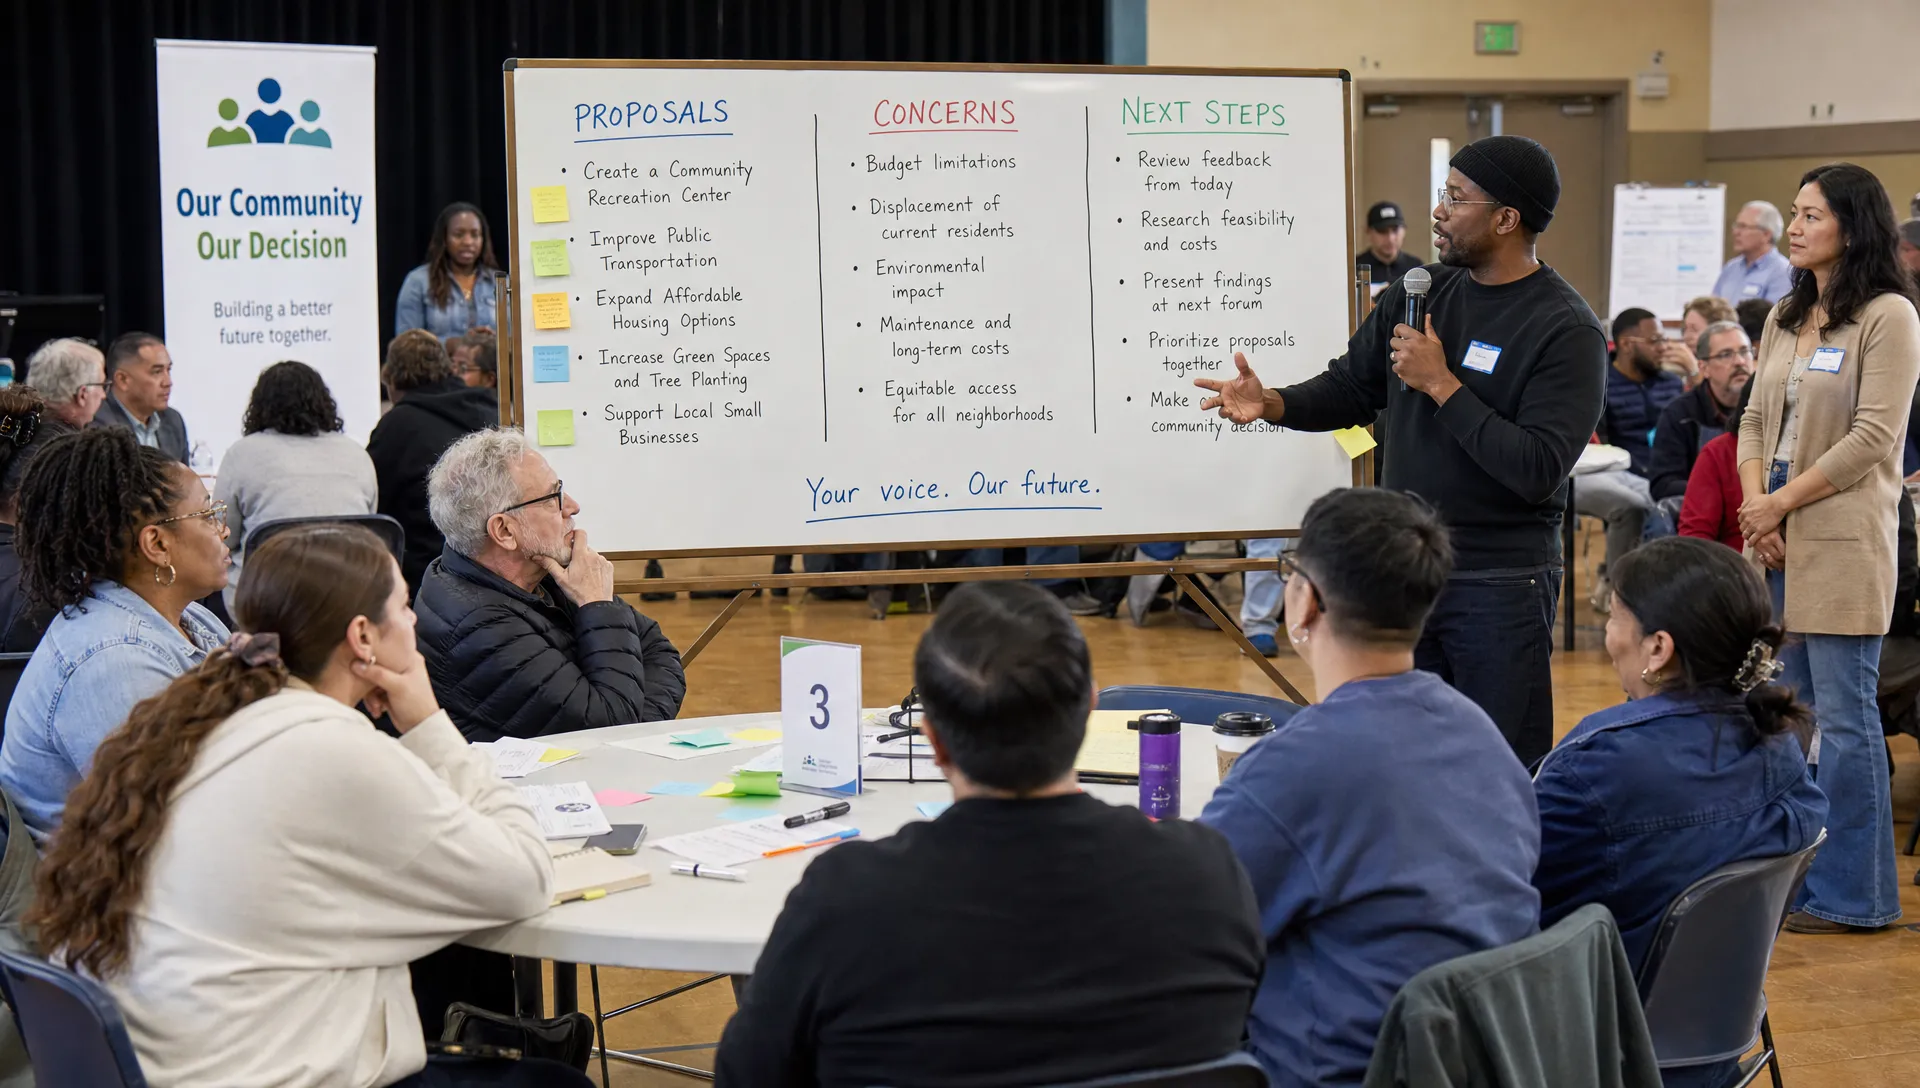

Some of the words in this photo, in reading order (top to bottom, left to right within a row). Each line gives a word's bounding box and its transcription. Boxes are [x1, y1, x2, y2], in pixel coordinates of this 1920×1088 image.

[575, 99, 729, 132] PROPOSALS
[874, 99, 1015, 127] CONCERNS
[1123, 96, 1191, 125] NEXT
[1206, 100, 1285, 126] STEPS
[866, 154, 922, 180] Budget
[935, 153, 1016, 170] limitations
[1138, 150, 1189, 167] Review
[1202, 150, 1271, 167] feedback
[584, 161, 639, 180] Create
[649, 168, 658, 178] a
[670, 160, 752, 186] Community
[588, 189, 670, 206] Recreation
[682, 187, 731, 202] Center
[1145, 175, 1180, 191] from
[1190, 176, 1233, 199] today
[176, 187, 222, 217] Our
[230, 186, 363, 225] Community
[870, 196, 973, 220] Displacement
[984, 194, 1000, 211] of
[882, 224, 937, 239] current
[948, 222, 1014, 237] residents
[1142, 210, 1209, 227] Research
[1221, 209, 1294, 235] feasibility
[197, 231, 241, 260] Our
[249, 229, 347, 259] Decision
[590, 231, 656, 252] Improve
[667, 227, 711, 243] Public
[1144, 236, 1169, 251] and
[1180, 235, 1217, 250] costs
[600, 253, 717, 276] Transportation
[877, 256, 984, 275] Environmental
[893, 282, 944, 304] impact
[1144, 272, 1204, 289] Present
[1214, 271, 1271, 295] findings
[597, 289, 652, 310] Expand
[664, 286, 743, 303] Affordable
[1152, 297, 1168, 312] at
[1179, 296, 1211, 311] next
[1221, 294, 1262, 310] forum
[214, 301, 273, 322] Building
[278, 304, 285, 316] a
[290, 300, 332, 316] better
[613, 313, 668, 336] Housing
[681, 312, 735, 334] Options
[881, 316, 974, 333] Maintenance
[985, 313, 1011, 329] and
[220, 328, 264, 344] future
[269, 328, 331, 347] together.
[1149, 331, 1219, 348] Prioritize
[1229, 331, 1295, 353] proposals
[599, 349, 664, 365] Increase
[673, 347, 714, 364] Green
[724, 347, 770, 368] Spaces
[893, 341, 962, 364] long-term
[972, 340, 1009, 354] costs
[1163, 356, 1222, 378] together
[615, 372, 639, 388] and
[650, 373, 681, 387] Tree
[692, 371, 747, 393] Planting
[886, 380, 956, 403] Equitable
[969, 384, 1016, 394] access
[1151, 391, 1189, 407] Make
[605, 404, 663, 426] Support
[675, 402, 712, 419] Local
[725, 401, 761, 417] Small
[893, 406, 916, 423] for
[927, 406, 944, 422] all
[957, 405, 1053, 429] neighborhoods
[619, 429, 698, 445] Businesses
[1152, 418, 1222, 441] community
[806, 477, 859, 511] Your
[881, 479, 948, 502] voice.
[969, 471, 1008, 495] Our
[1021, 469, 1099, 495] future.
[810, 684, 829, 729] 3
